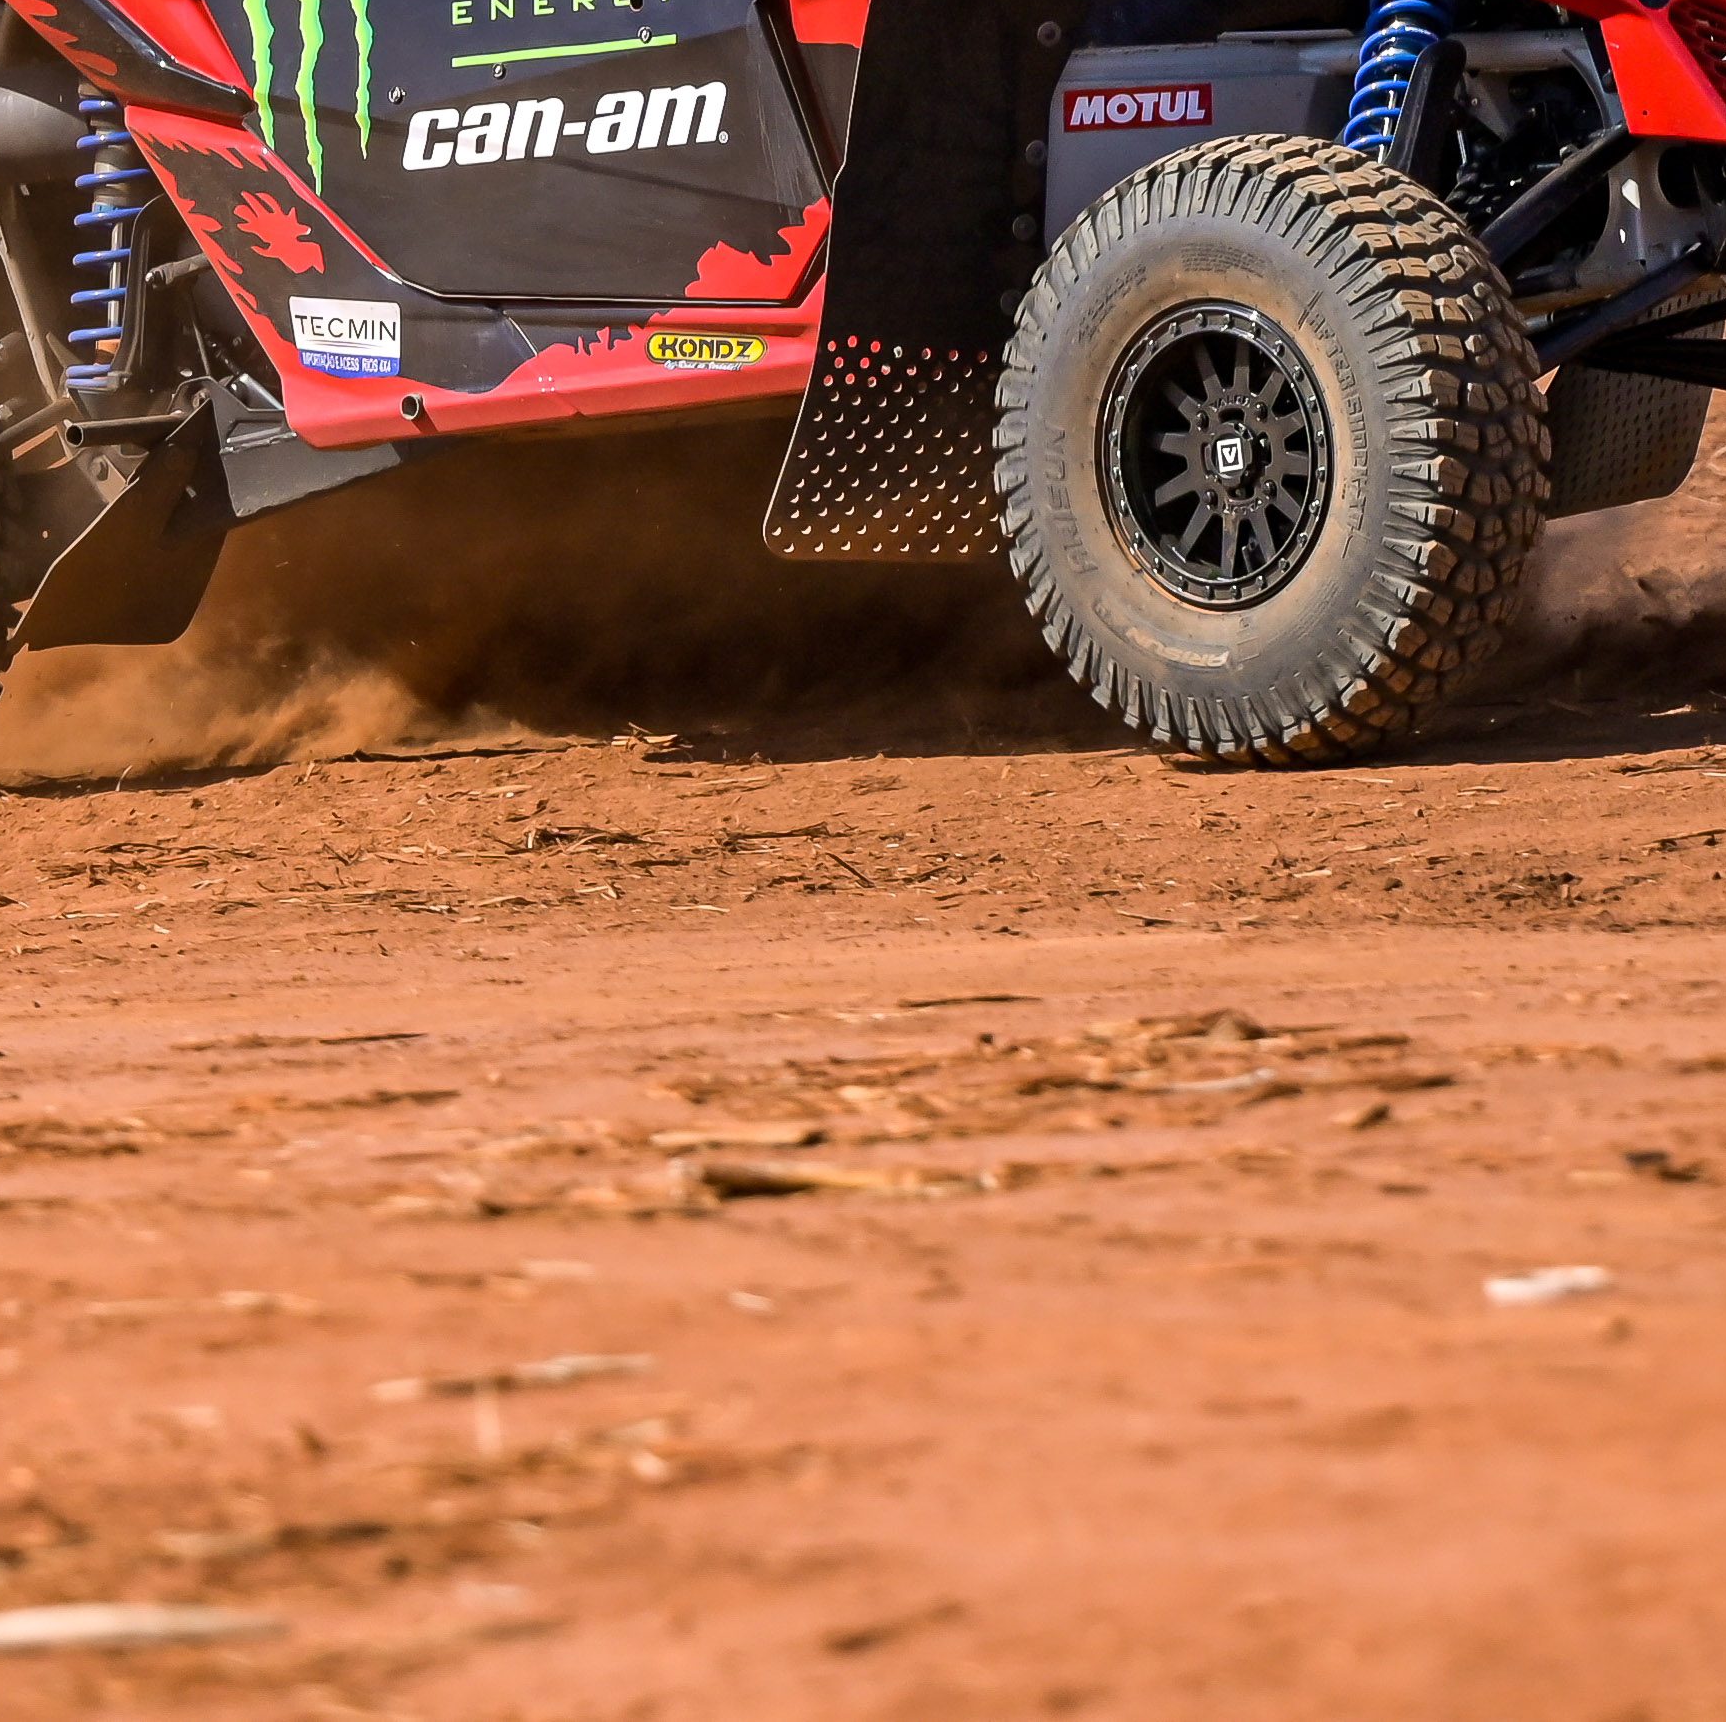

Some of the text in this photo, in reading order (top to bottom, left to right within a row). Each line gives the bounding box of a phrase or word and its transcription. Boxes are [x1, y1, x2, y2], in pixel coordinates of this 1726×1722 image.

[1069, 89, 1206, 126] MOTUL
[401, 81, 727, 171] can-am
[294, 314, 396, 341] TECMIN
[658, 337, 754, 359] KONDZ
